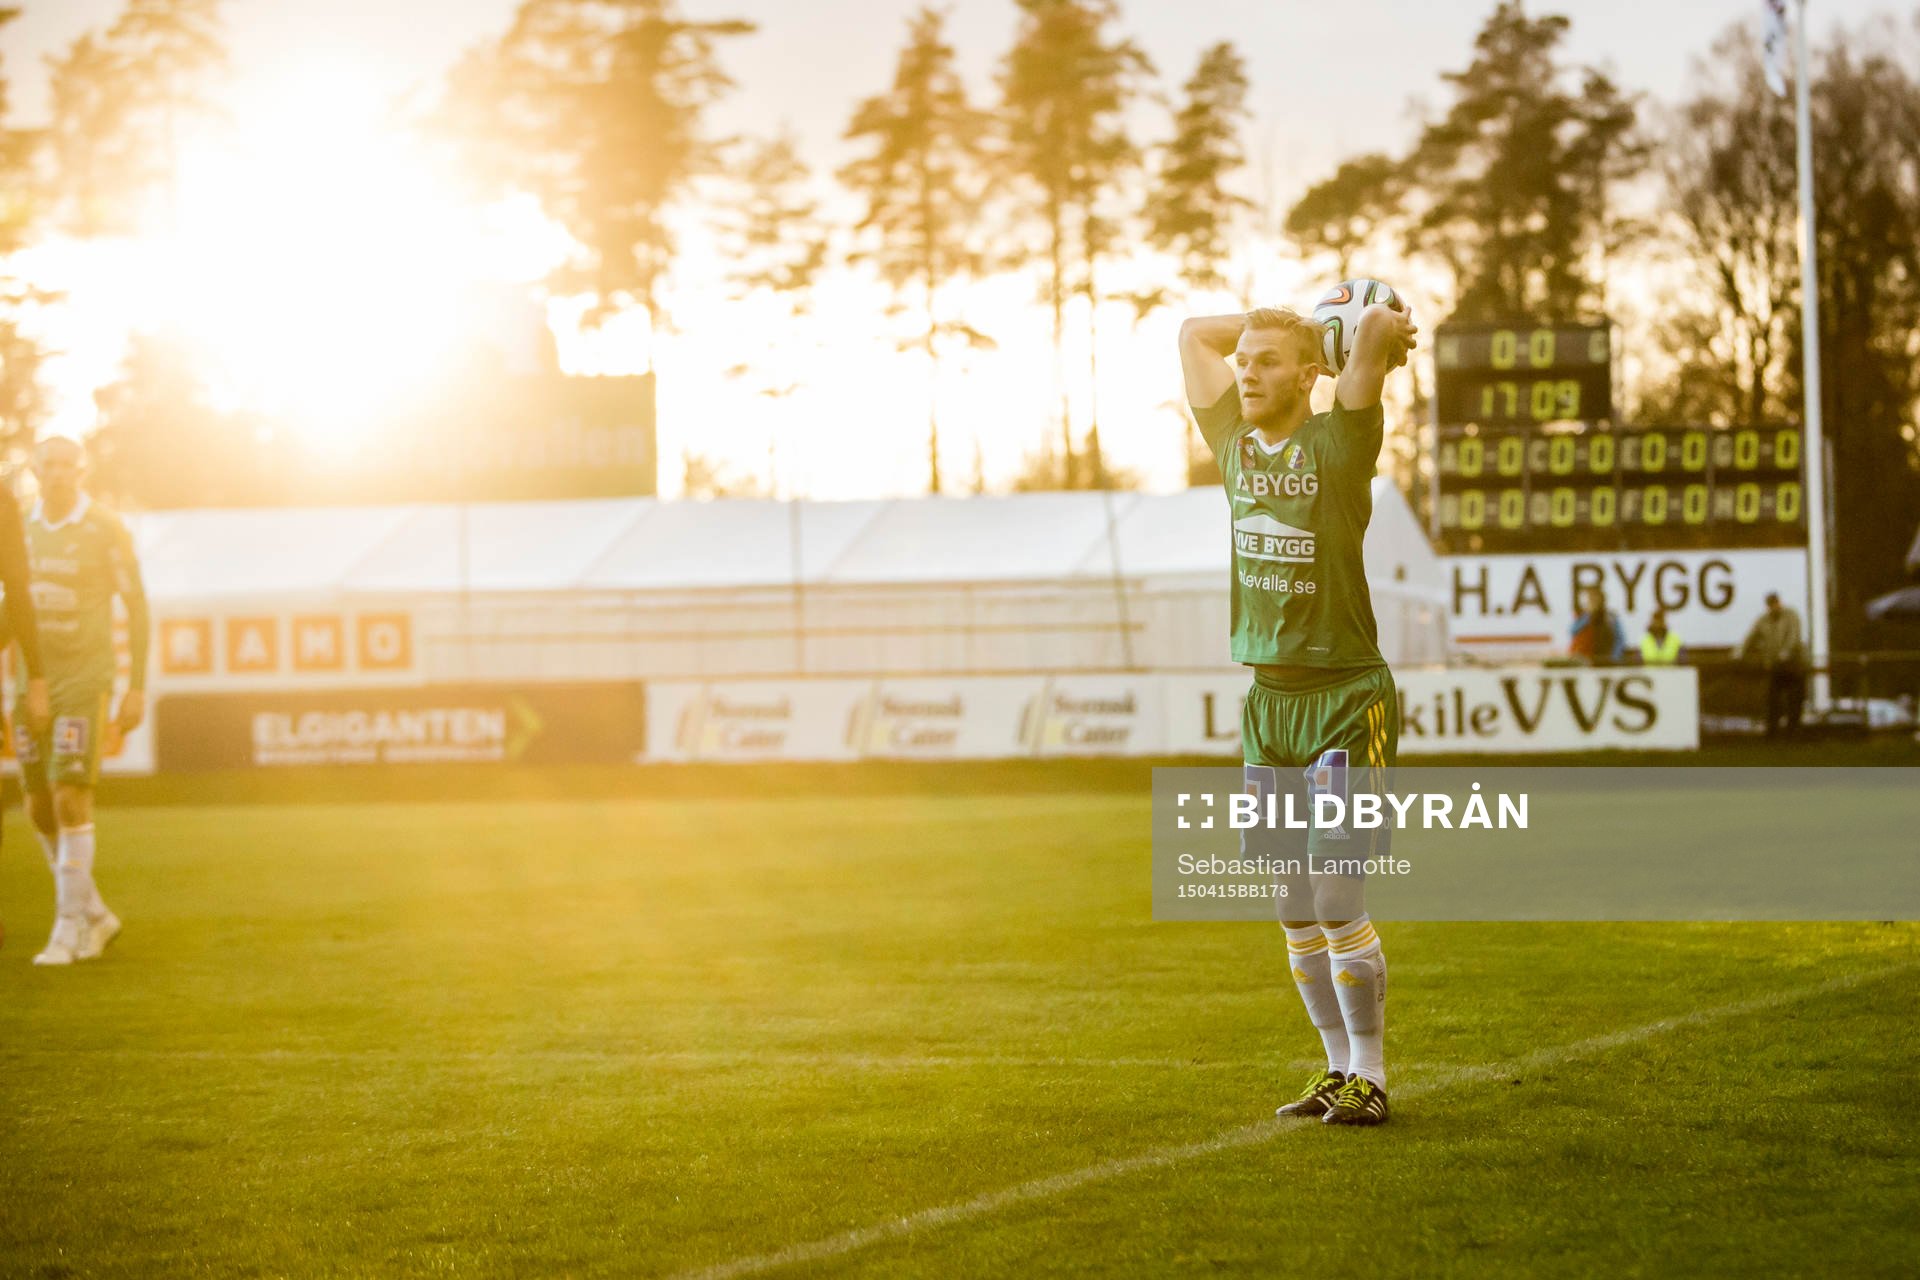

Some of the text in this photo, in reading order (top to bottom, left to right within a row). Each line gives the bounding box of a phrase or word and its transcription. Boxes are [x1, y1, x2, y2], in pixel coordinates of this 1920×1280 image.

[1253, 473, 1319, 496] BYGG
[1264, 536, 1315, 556] BYGG
[1452, 563, 1550, 616] H.A
